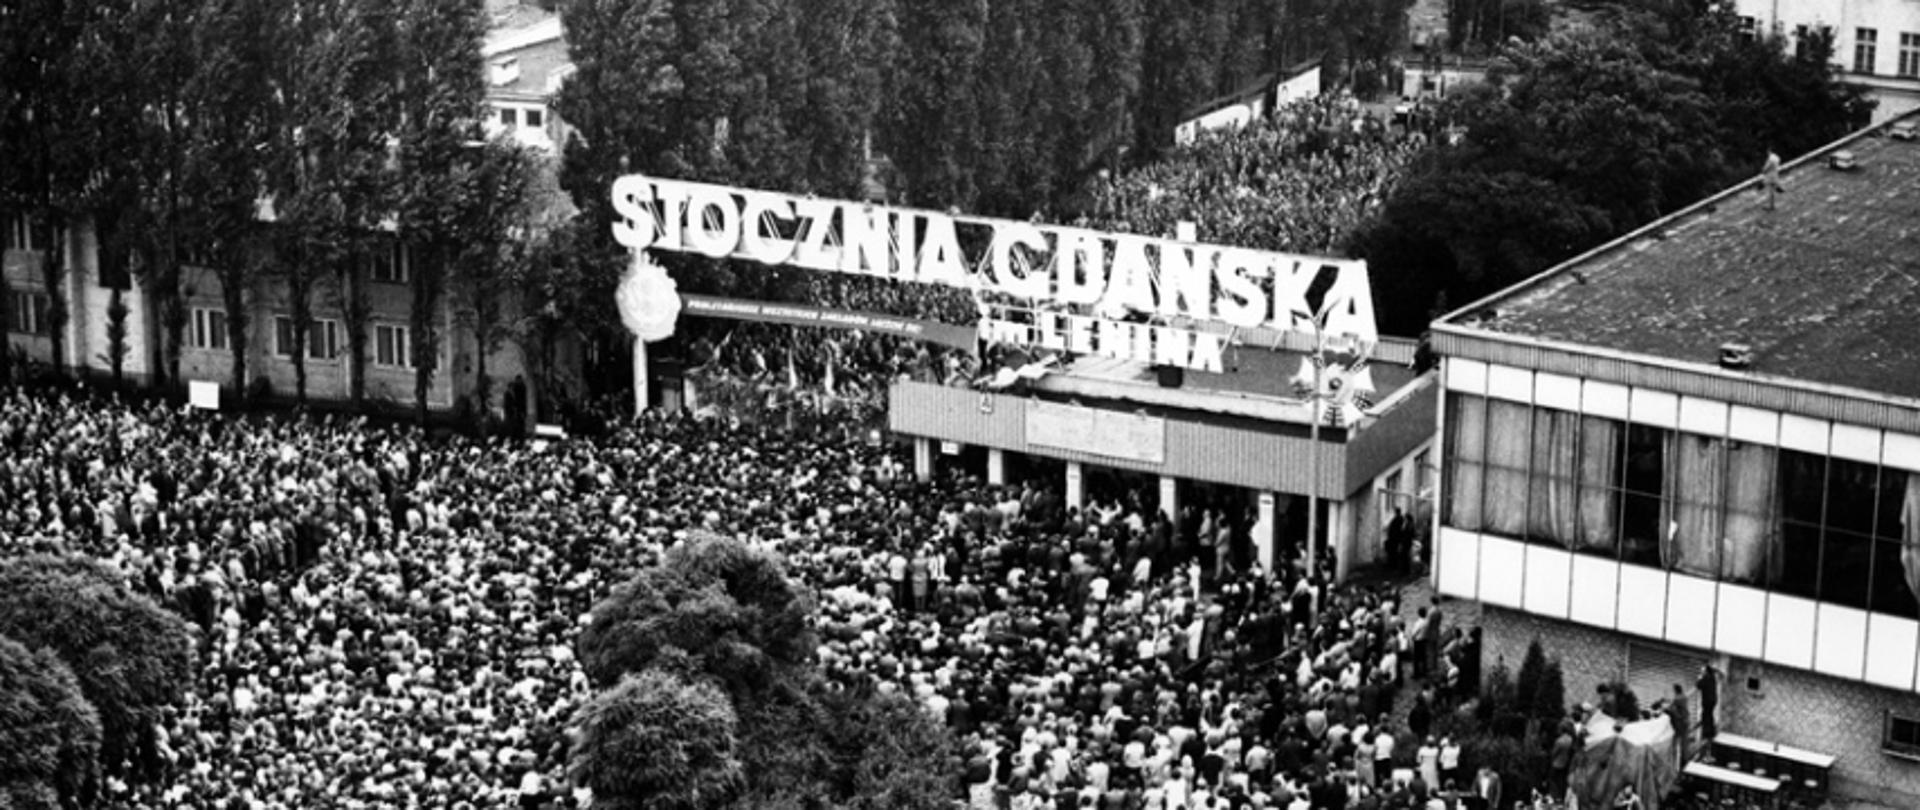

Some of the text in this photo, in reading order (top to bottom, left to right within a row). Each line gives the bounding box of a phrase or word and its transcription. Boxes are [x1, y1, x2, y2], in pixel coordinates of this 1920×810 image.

[611, 174, 1377, 341] STOCZNIA GDAŃSKA
[1042, 310, 1224, 374] LENINA
